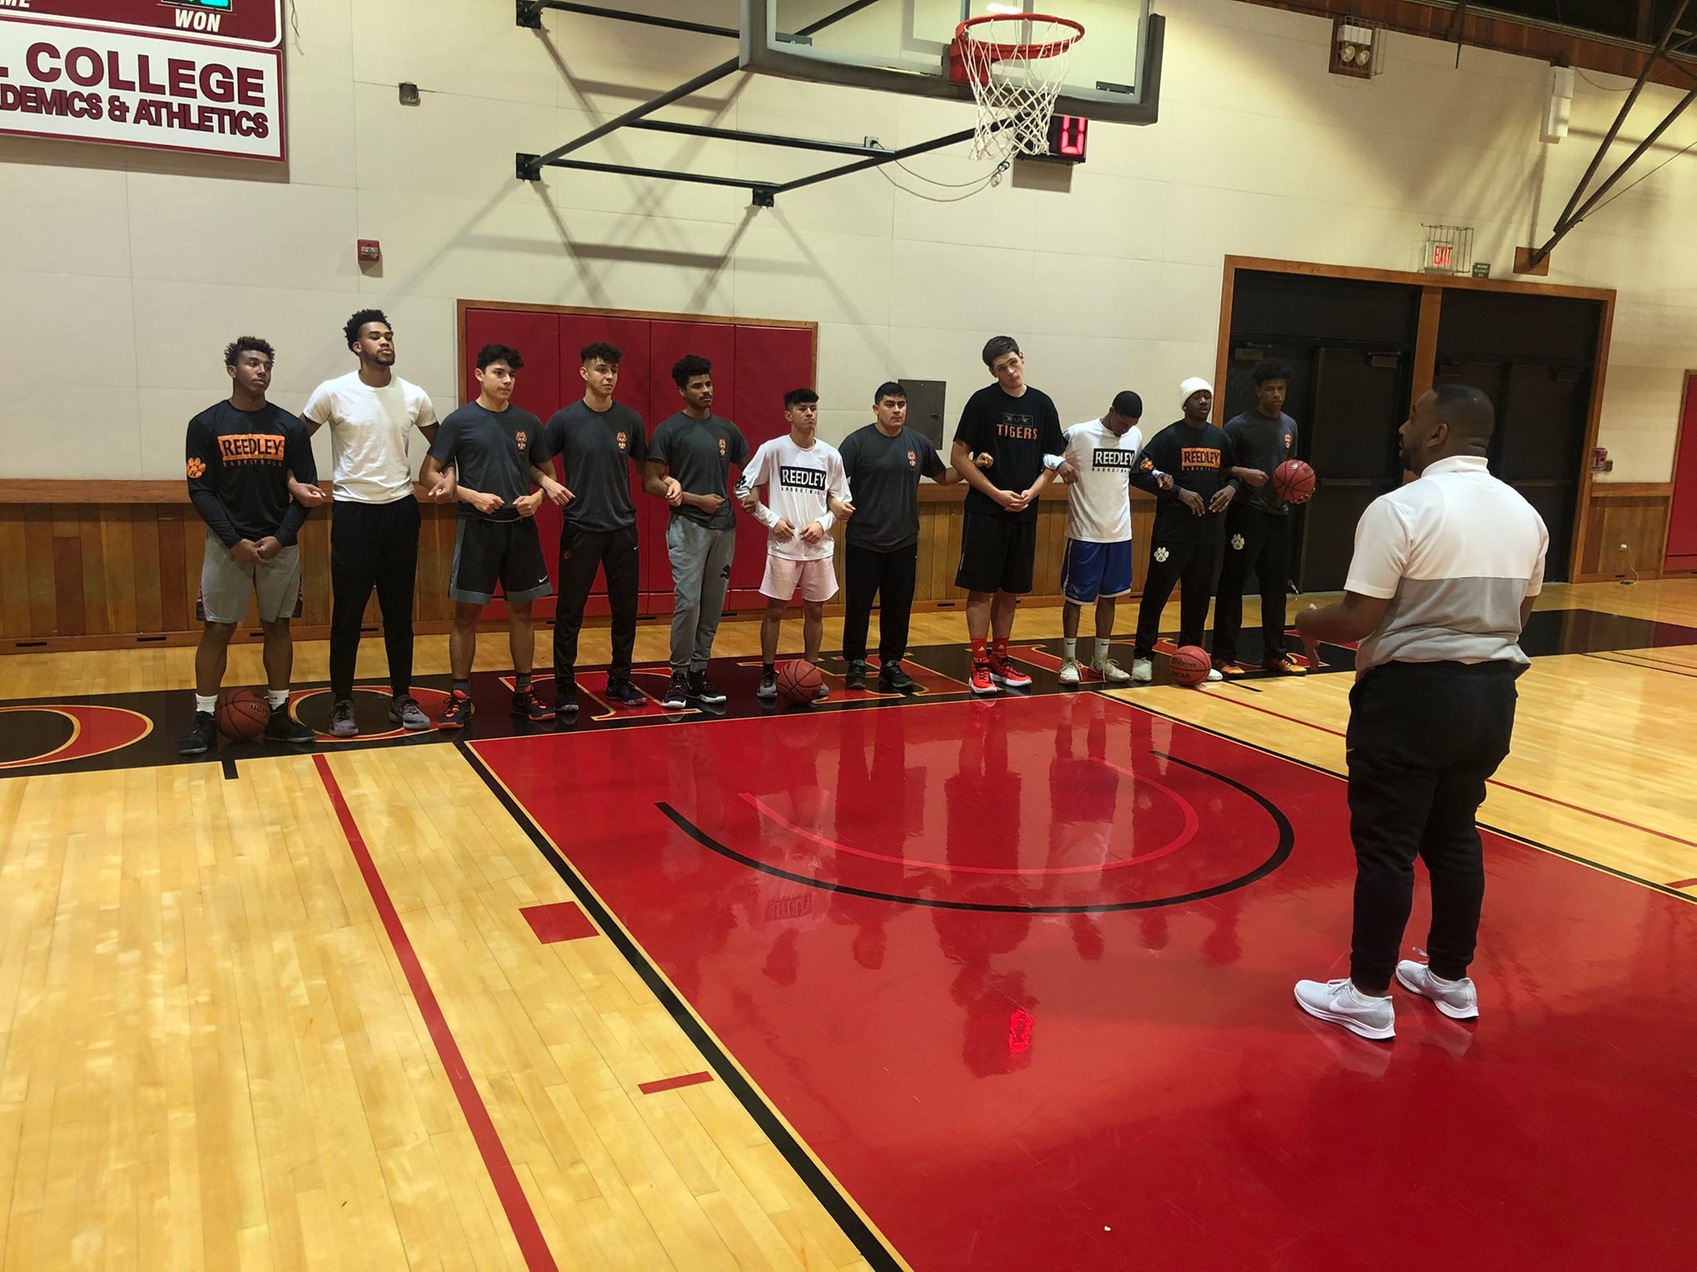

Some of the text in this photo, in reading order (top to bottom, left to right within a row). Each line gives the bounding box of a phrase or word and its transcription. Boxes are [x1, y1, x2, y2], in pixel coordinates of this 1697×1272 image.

[175, 9, 221, 33] WON
[26, 42, 265, 107] COLLEGE
[0, 83, 269, 139] DEMICS & ATHLETICS
[1433, 245, 1453, 265] EXIT
[996, 423, 1039, 440] TIGERS
[222, 438, 282, 456] REEDLEY
[1095, 451, 1134, 465] REEDLEY
[1184, 450, 1220, 465] REEDLEY
[782, 469, 826, 487] REEDLEY
